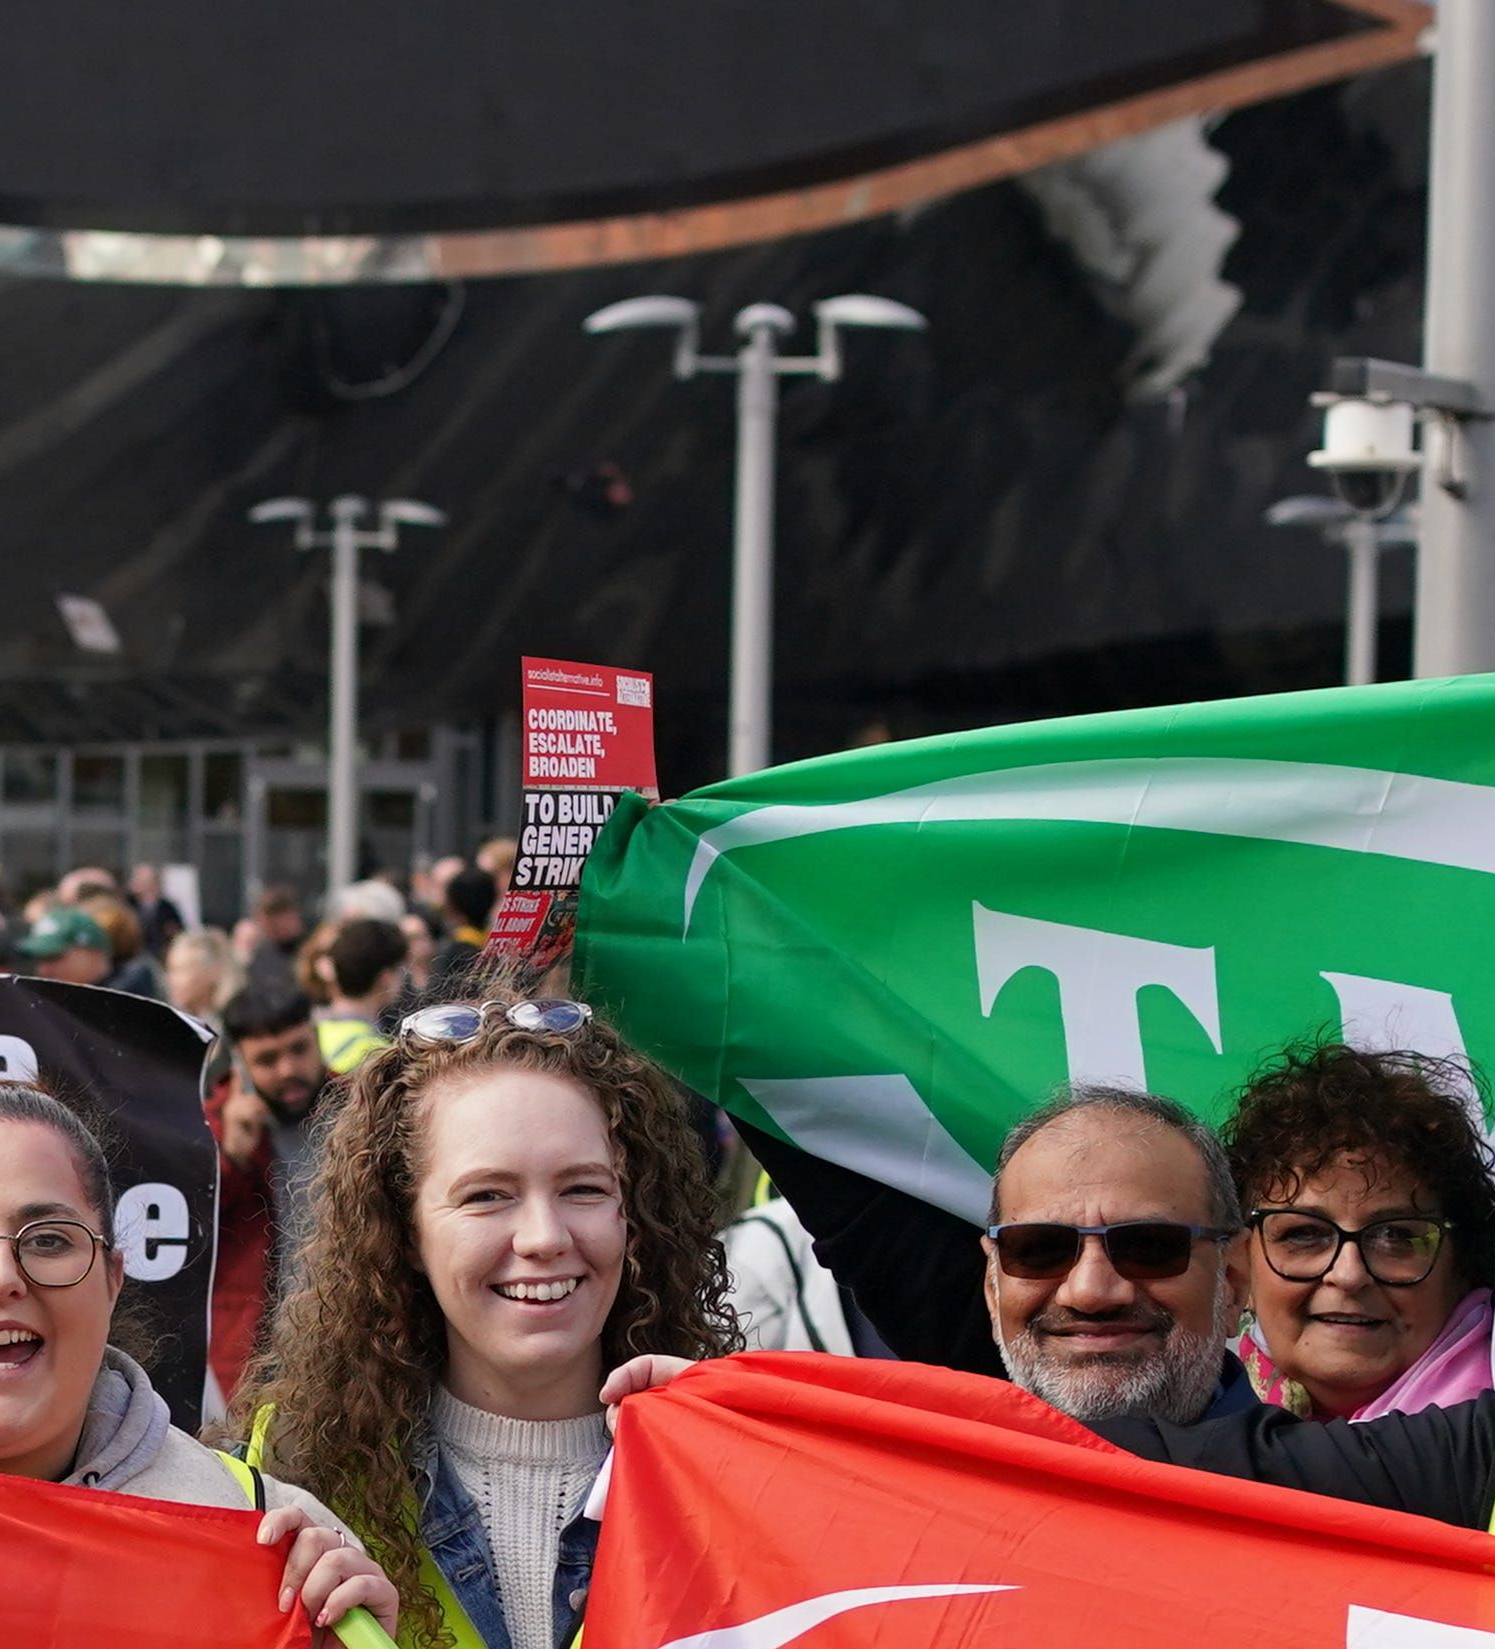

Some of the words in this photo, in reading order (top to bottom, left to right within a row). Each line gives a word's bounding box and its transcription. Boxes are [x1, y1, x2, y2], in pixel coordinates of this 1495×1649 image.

[528, 708, 617, 735] COORDINATE,
[528, 732, 605, 758] ESCALATE,
[529, 756, 596, 778] BROADEN
[525, 794, 555, 824] TO
[558, 794, 614, 824] BUILD
[521, 825, 604, 855] GENER
[515, 857, 586, 886] STRIK
